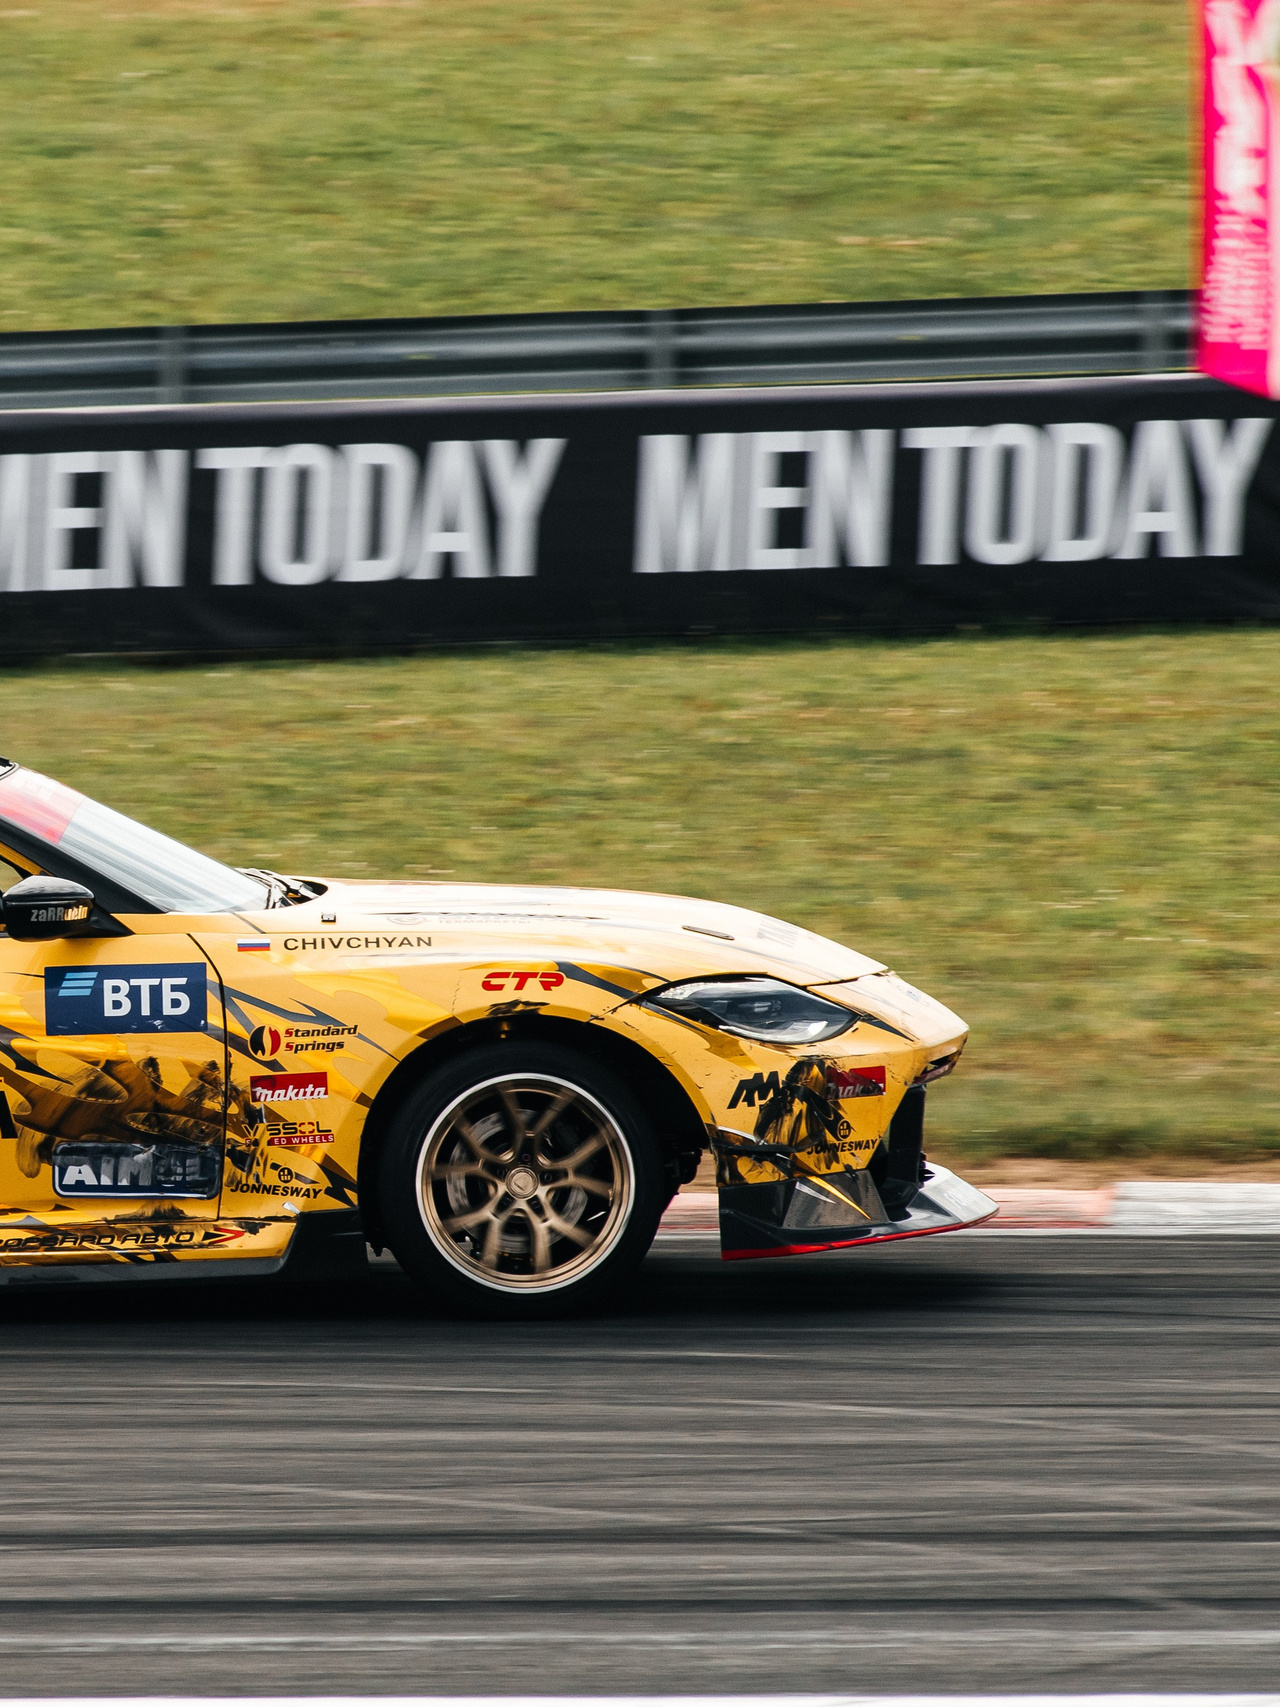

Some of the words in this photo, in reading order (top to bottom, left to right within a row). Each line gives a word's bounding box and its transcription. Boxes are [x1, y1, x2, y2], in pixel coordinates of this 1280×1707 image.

[628, 428, 896, 573] MEN
[900, 417, 1276, 566] TODAY
[194, 437, 569, 586] TODAY
[283, 936, 433, 951] CHIVCHYAN
[481, 971, 565, 992] CTR
[102, 977, 191, 1017] ВТБ
[284, 1025, 358, 1038] Standard
[284, 1040, 345, 1054] Springs
[251, 1083, 329, 1102] makita
[243, 1121, 332, 1137] VSSOL
[291, 1134, 334, 1145] WHEELS
[230, 1183, 323, 1200] JONNESWAY
